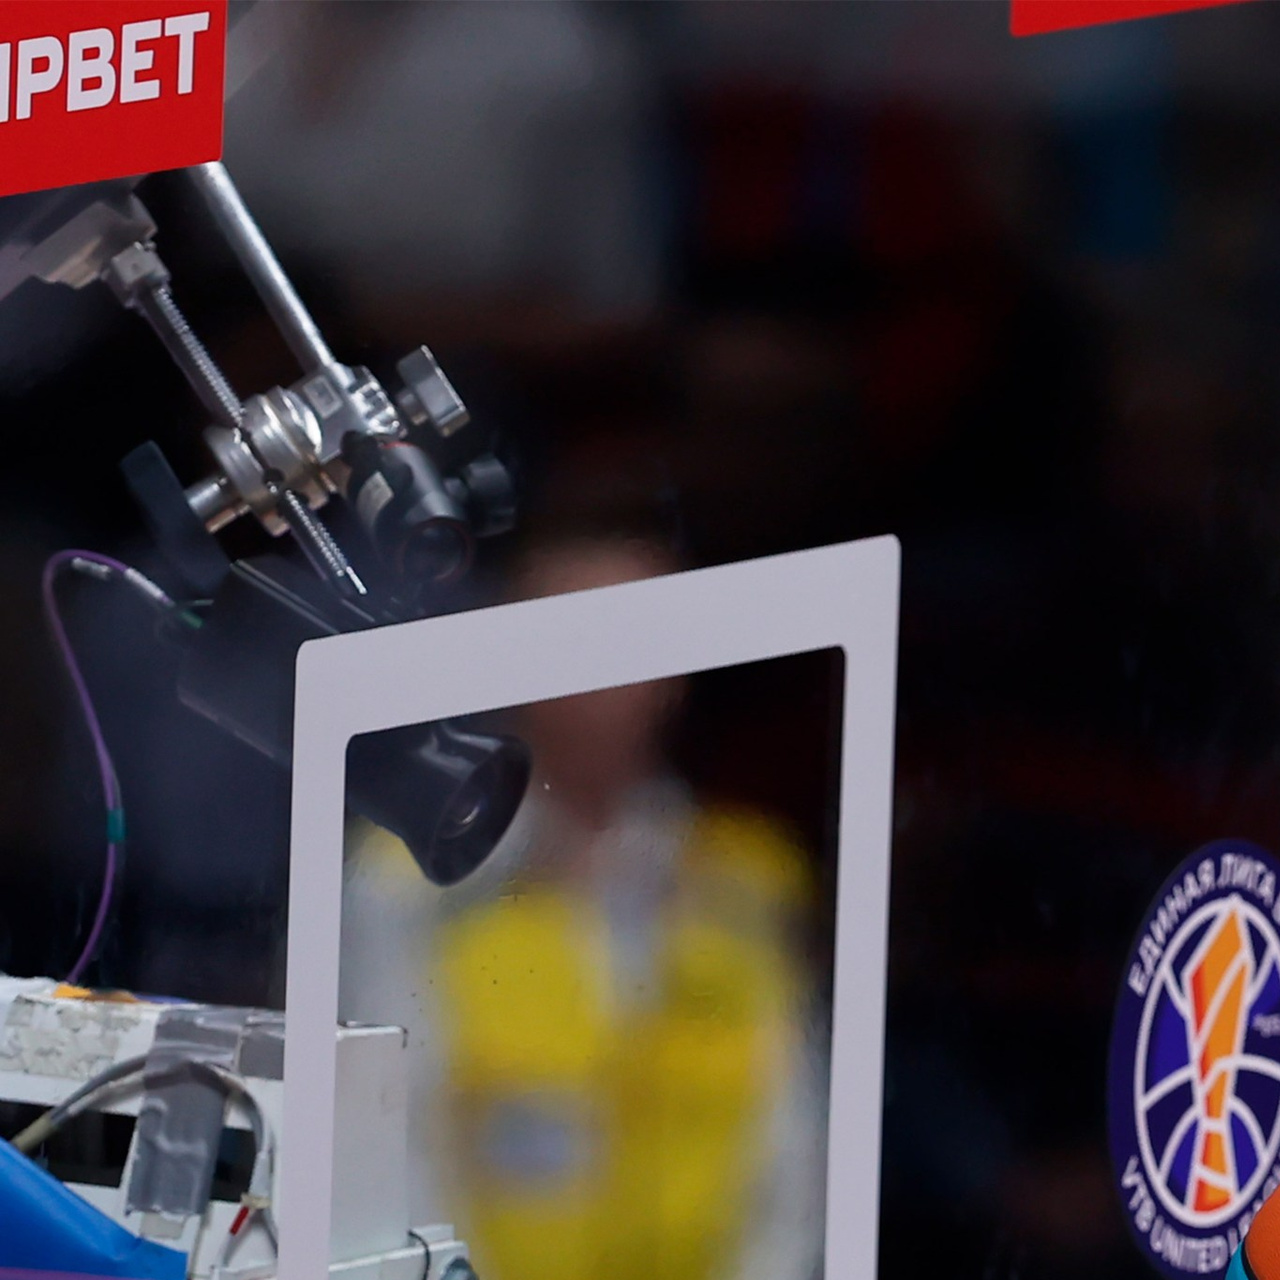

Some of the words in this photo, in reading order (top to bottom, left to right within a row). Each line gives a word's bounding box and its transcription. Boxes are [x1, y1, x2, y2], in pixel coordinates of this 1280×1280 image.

[0, 11, 210, 123] PBET
[1127, 857, 1216, 996] ЕДИНАЯ
[1216, 852, 1276, 908] ЛИГА
[1121, 1154, 1157, 1233] VTB
[1150, 1214, 1229, 1274] UNITED
